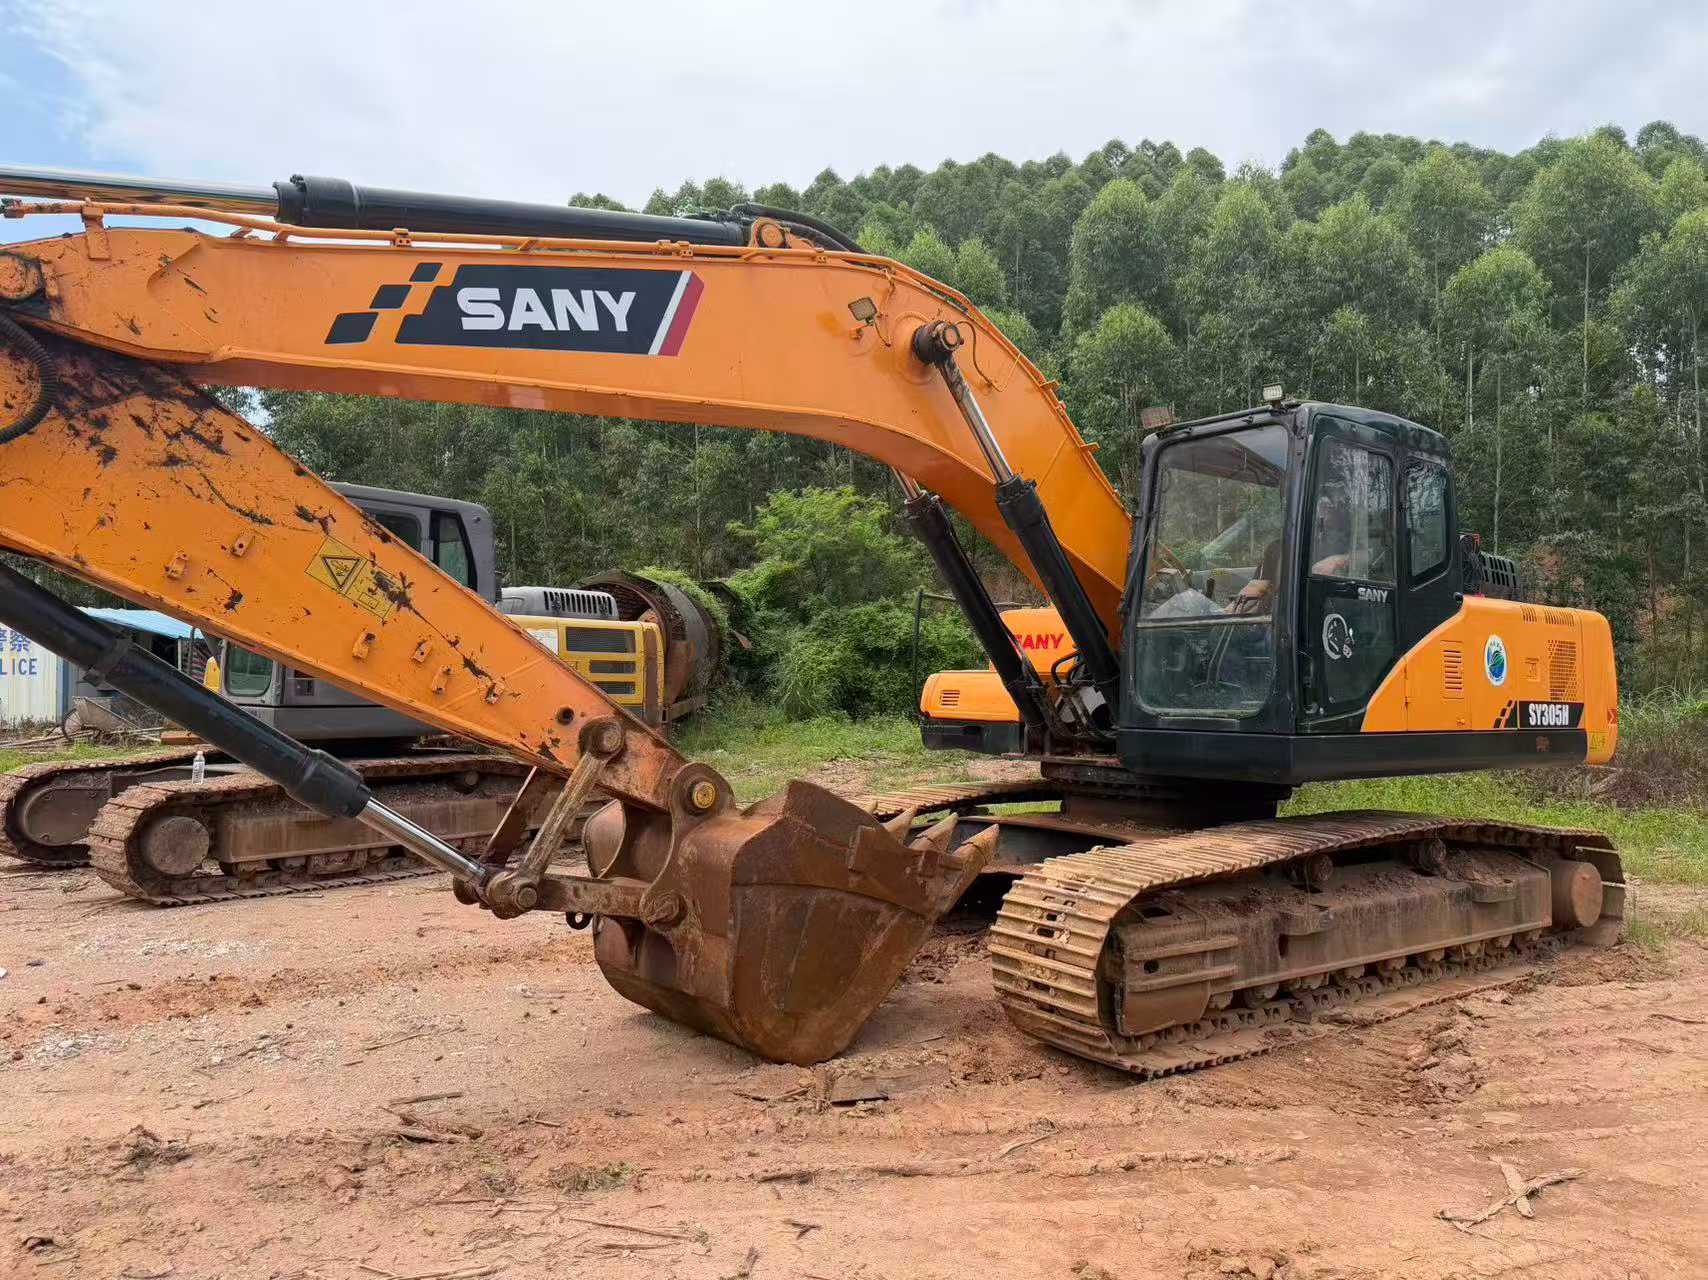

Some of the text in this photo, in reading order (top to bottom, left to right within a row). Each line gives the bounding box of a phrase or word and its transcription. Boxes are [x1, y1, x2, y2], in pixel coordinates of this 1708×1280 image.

[456, 287, 637, 333] SANY
[1357, 587, 1388, 603] SANY
[1528, 703, 1570, 726] SY305H
